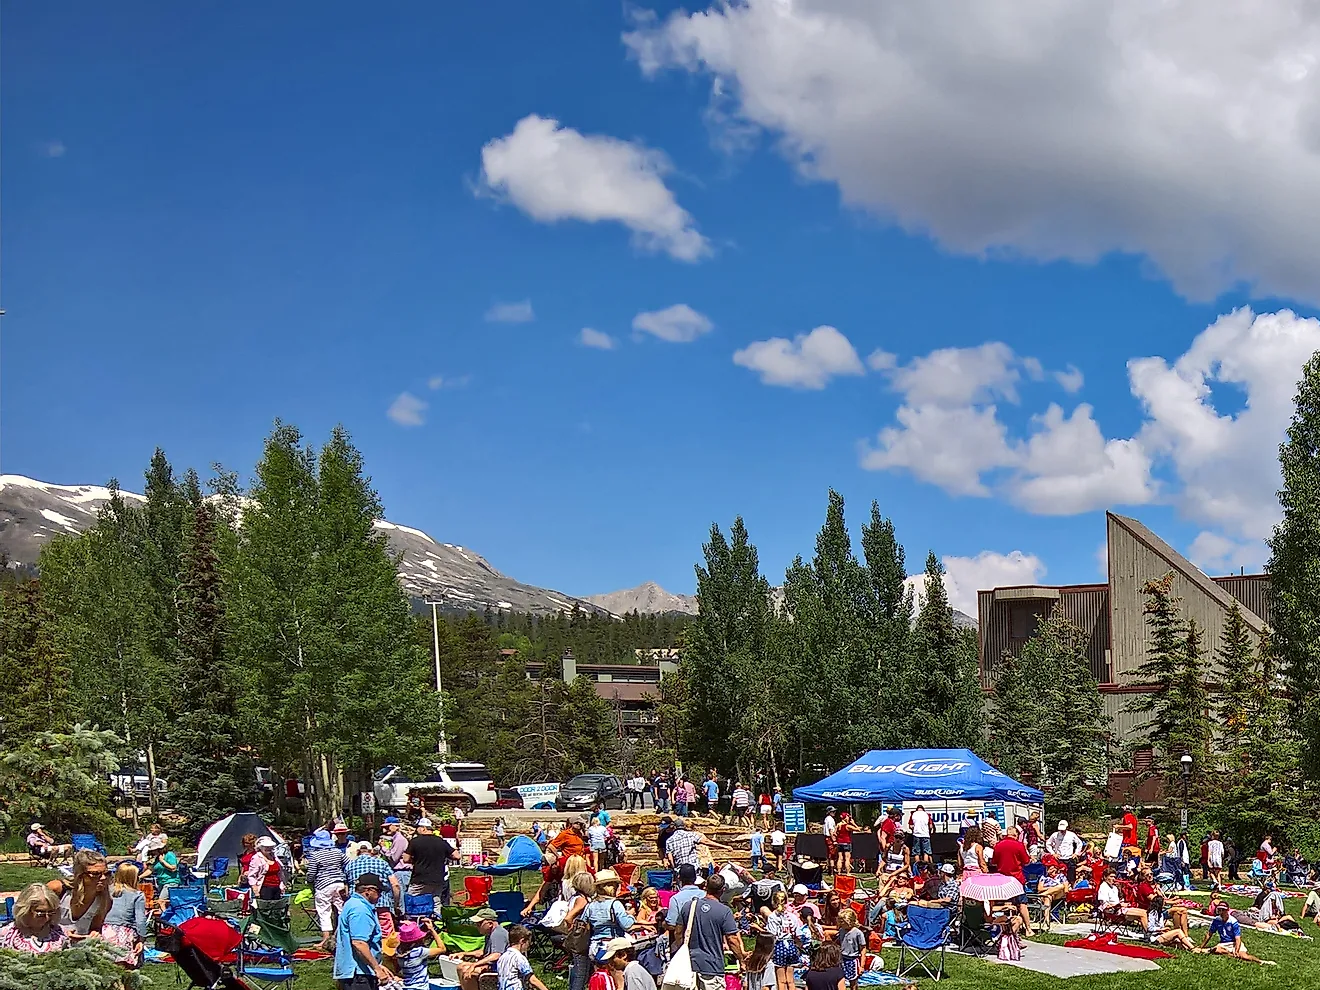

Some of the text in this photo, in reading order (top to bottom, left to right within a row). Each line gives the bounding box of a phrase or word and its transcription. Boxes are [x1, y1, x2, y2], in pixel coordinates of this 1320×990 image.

[848, 763, 971, 773] BUD LIGHT
[931, 812, 950, 823] UD
